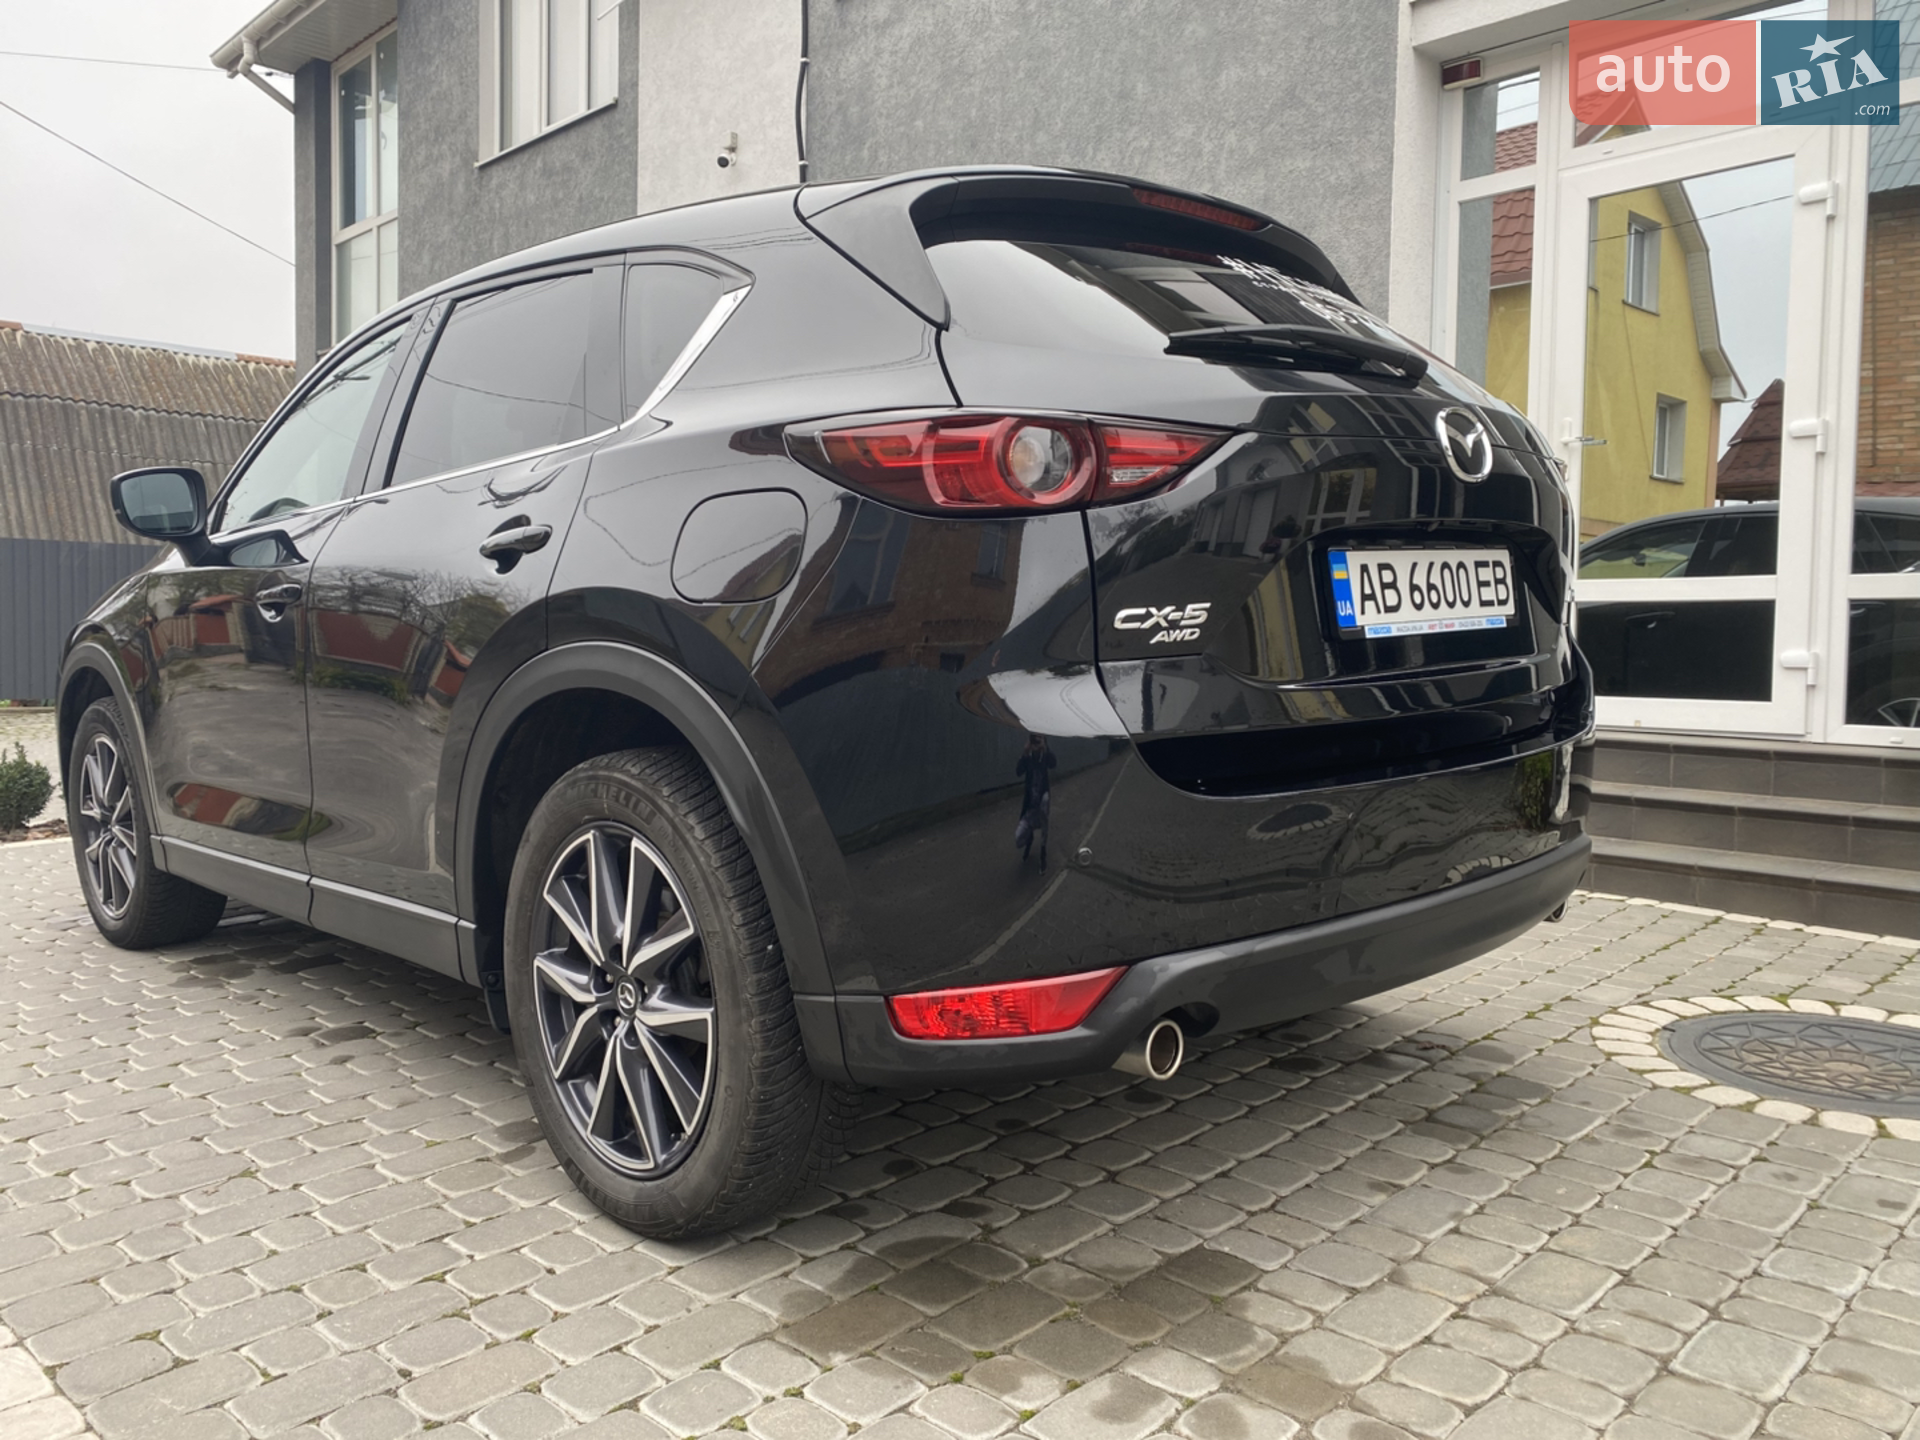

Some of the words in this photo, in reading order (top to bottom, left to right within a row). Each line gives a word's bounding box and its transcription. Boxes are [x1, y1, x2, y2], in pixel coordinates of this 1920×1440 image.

[1360, 562, 1402, 616] AB
[1409, 561, 1472, 612] 6600
[1473, 560, 1510, 608] EB
[1114, 602, 1211, 630] CX-5
[1337, 601, 1354, 617] UA
[1149, 628, 1201, 645] AWD
[566, 783, 652, 820] MICHELIN
